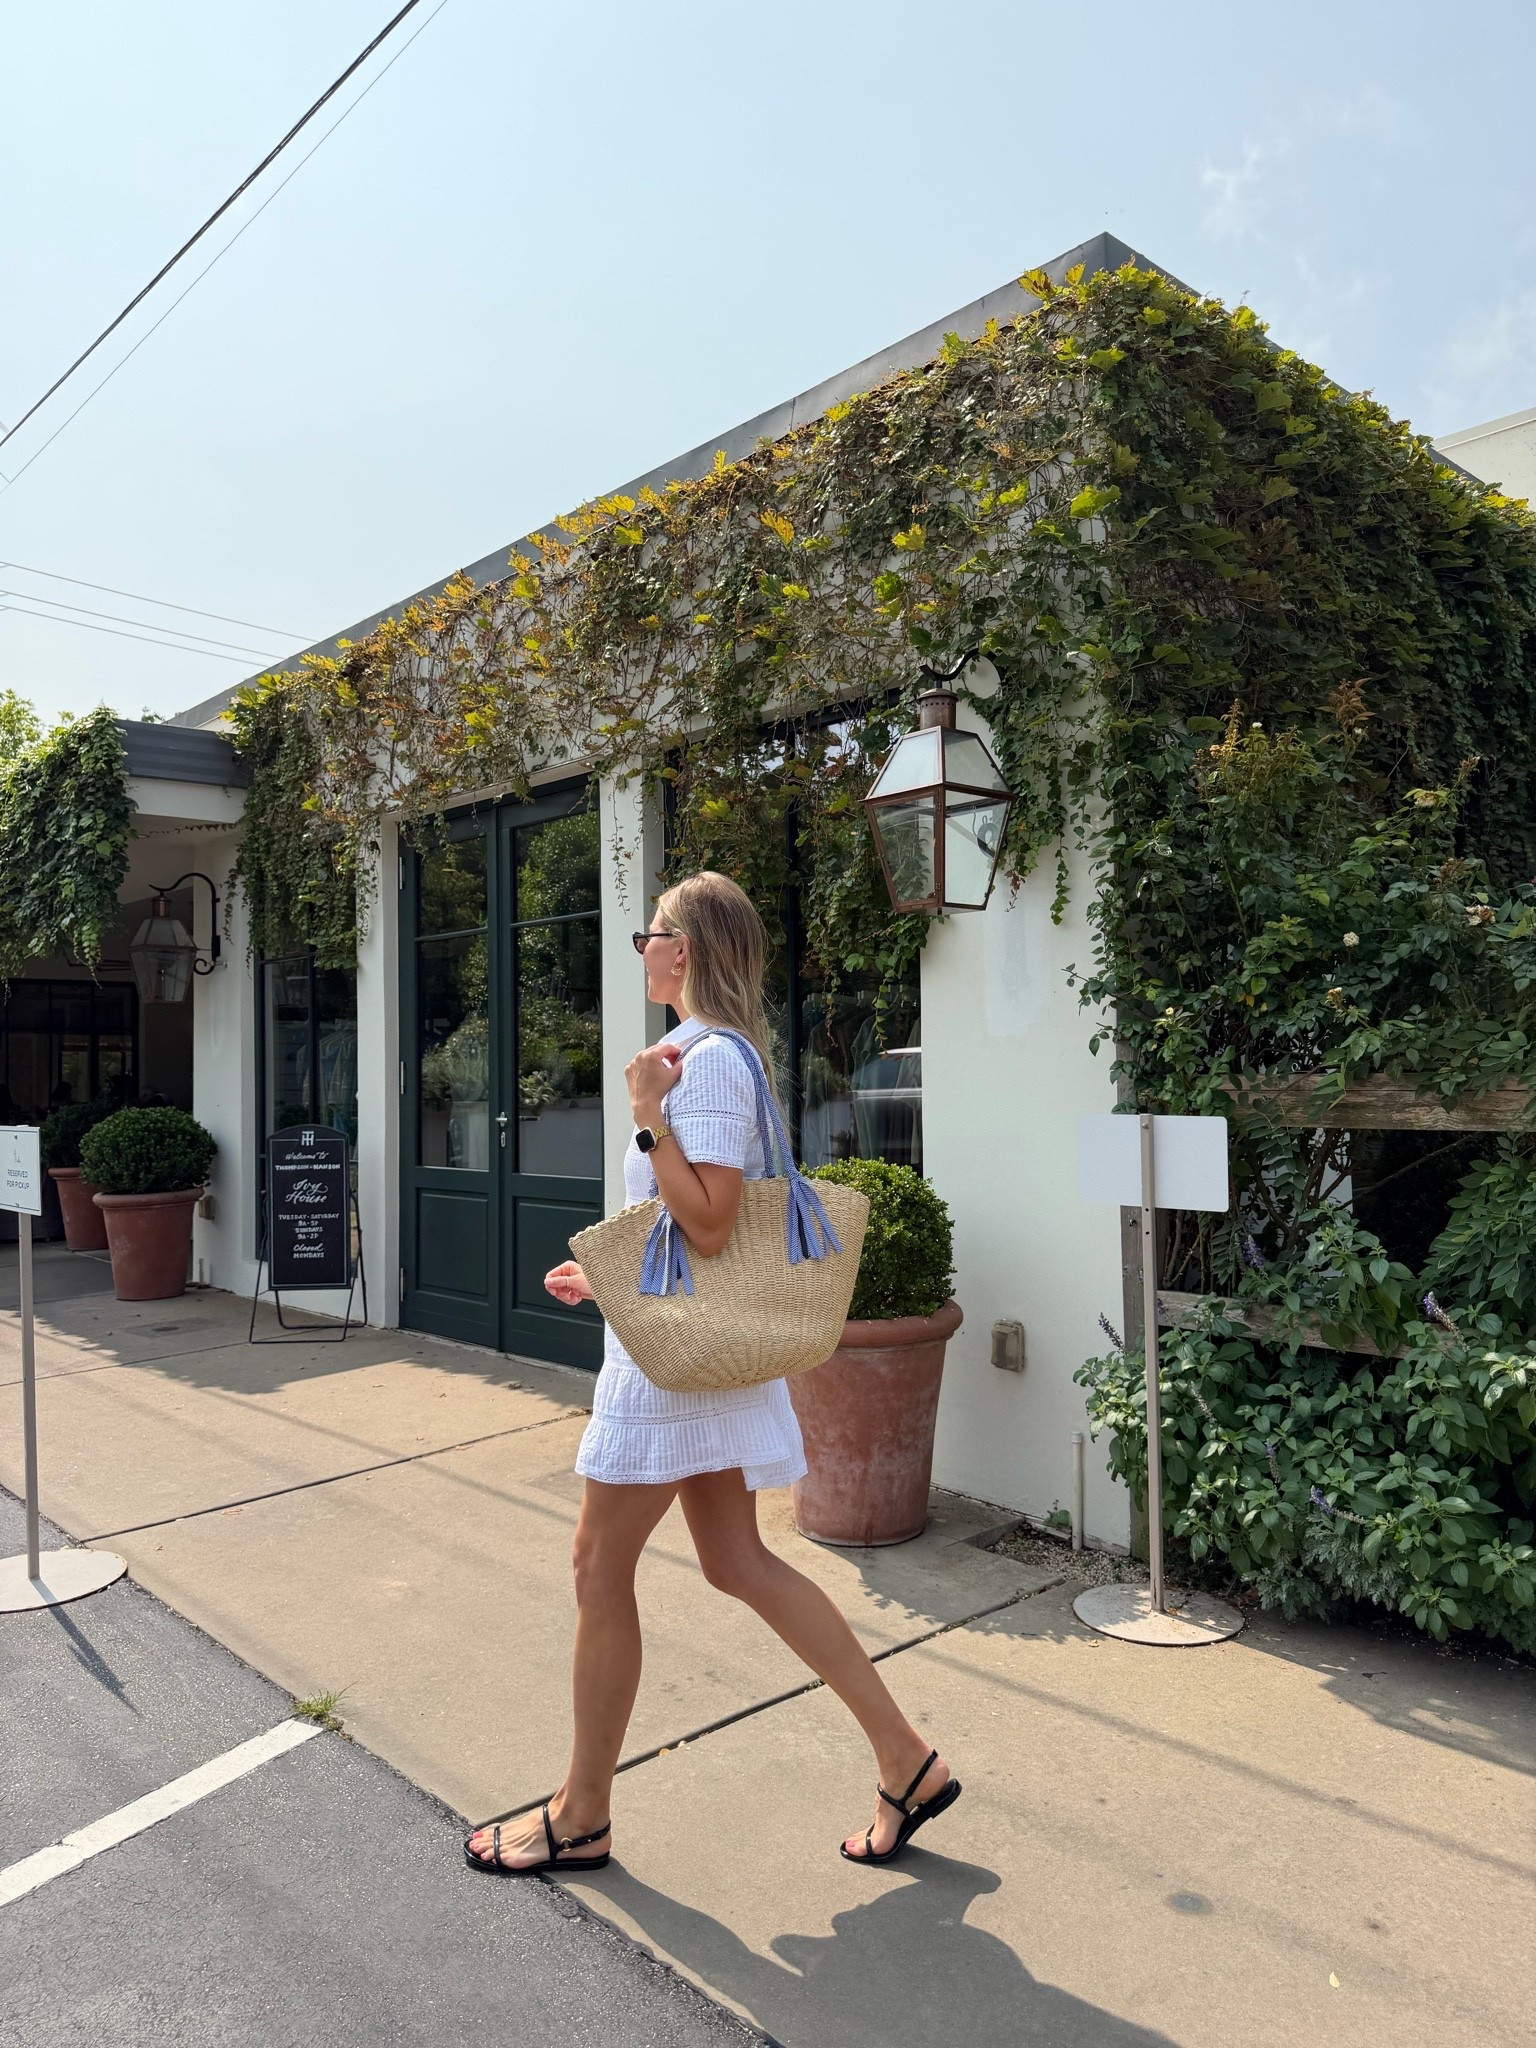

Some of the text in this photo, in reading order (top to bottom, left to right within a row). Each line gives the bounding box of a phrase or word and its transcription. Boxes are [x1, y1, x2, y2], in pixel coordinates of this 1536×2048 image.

[8, 1169, 28, 1178] RESERVED
[292, 1179, 328, 1196] Ivy
[285, 1190, 327, 1204] House
